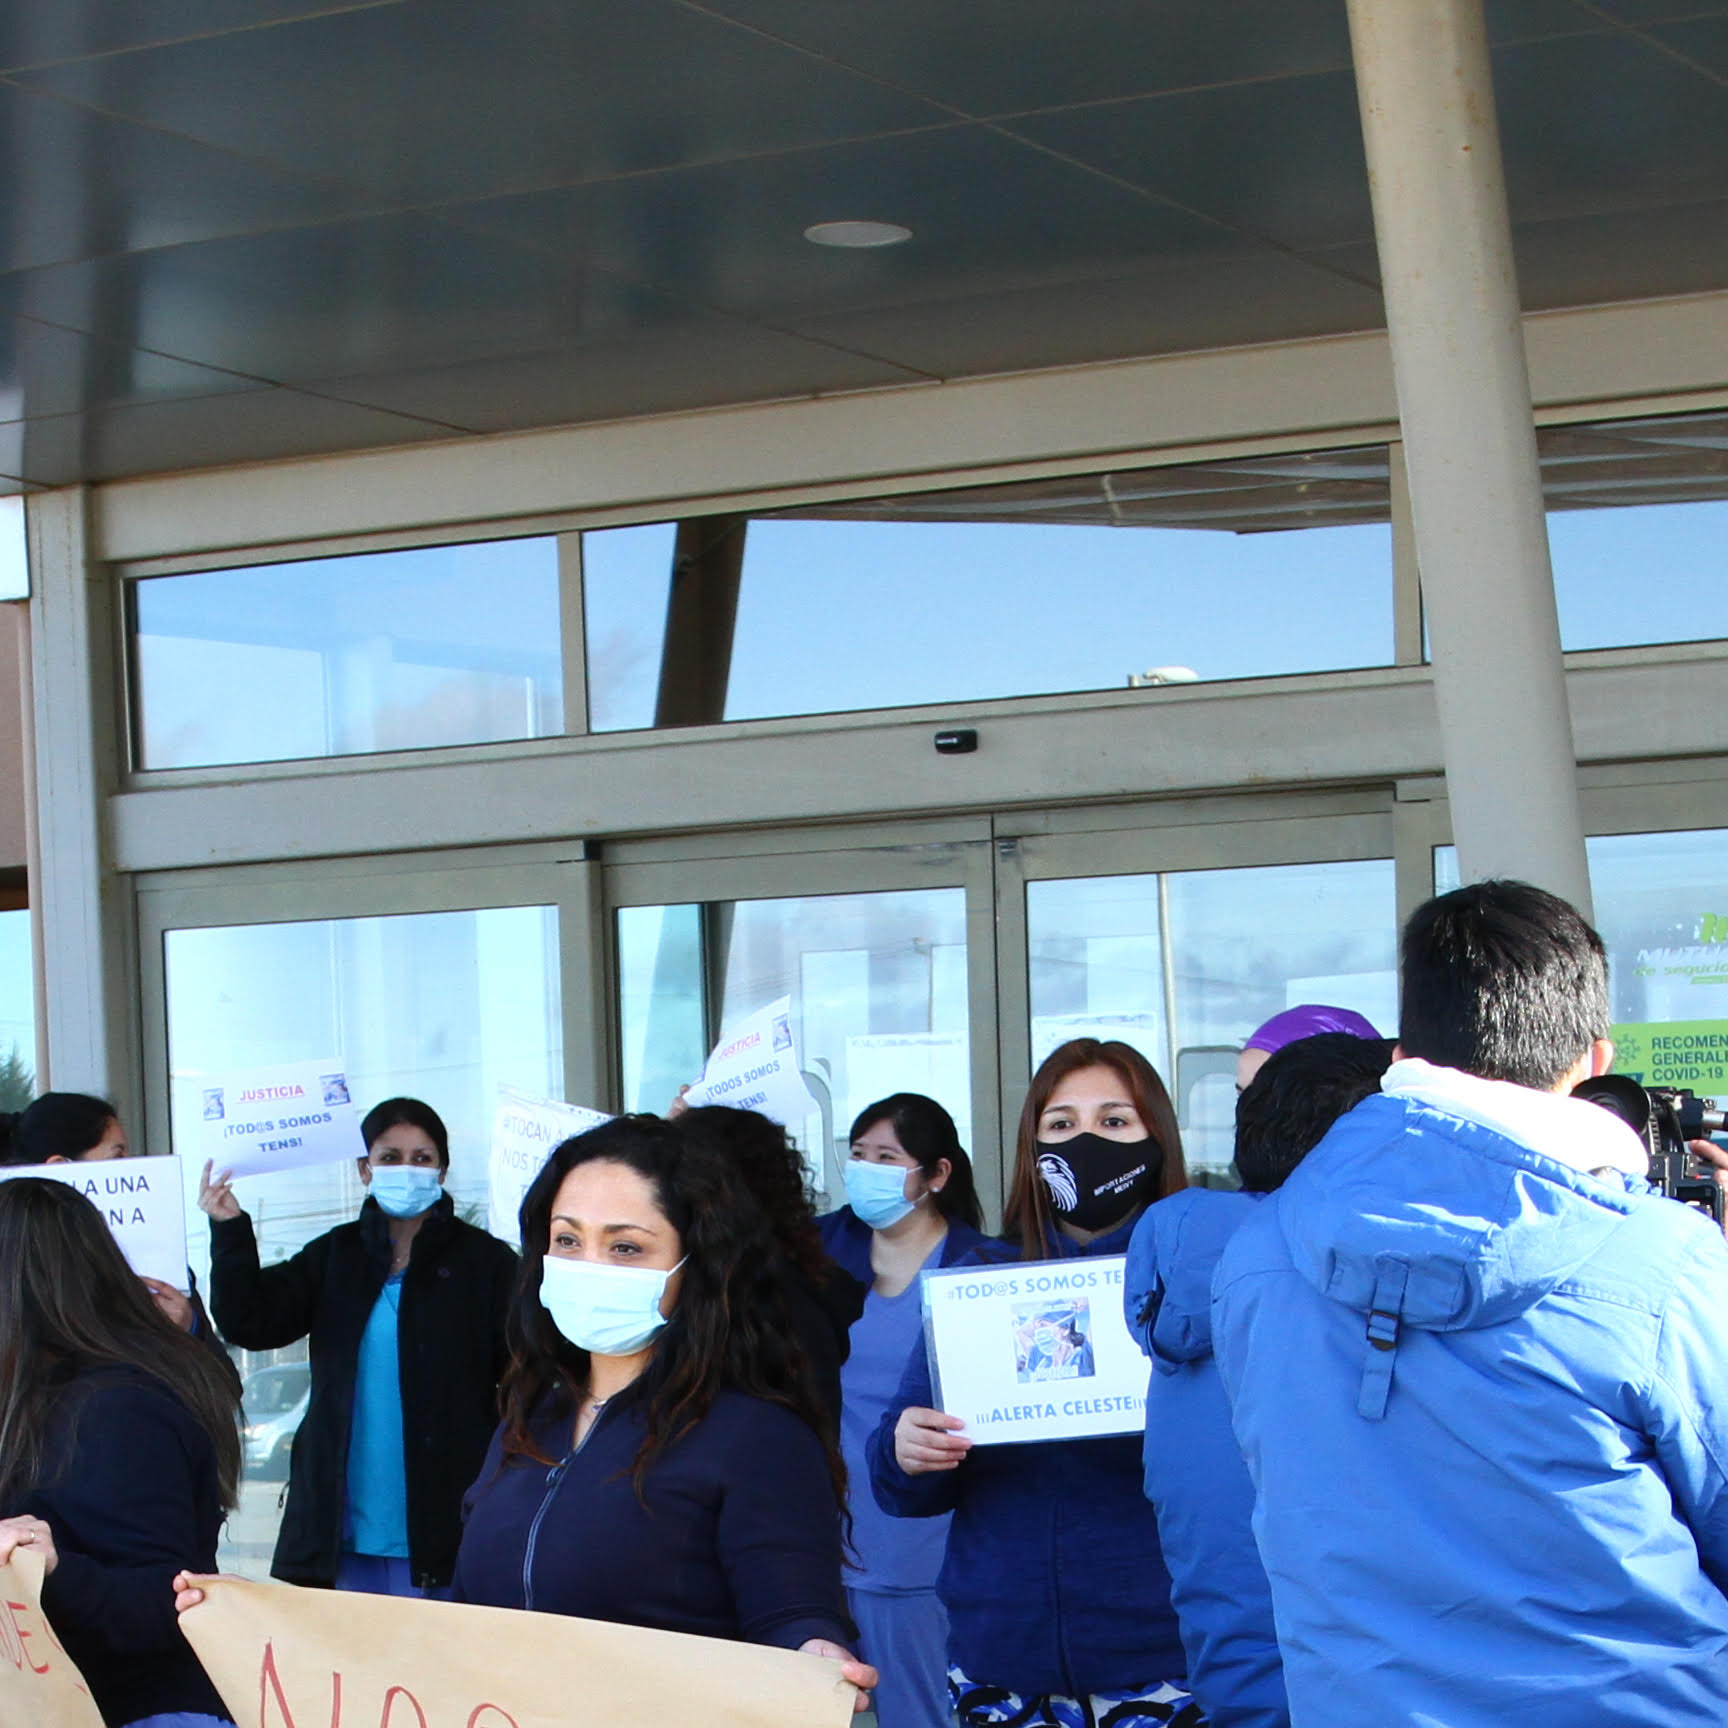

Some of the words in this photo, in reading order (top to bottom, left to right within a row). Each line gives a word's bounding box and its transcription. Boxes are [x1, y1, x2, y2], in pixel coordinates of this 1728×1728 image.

[743, 1060, 781, 1084] SOMOS
[1652, 1067, 1723, 1082] COVID-19
[239, 1084, 305, 1102] JUSTICIA
[277, 1112, 333, 1131] SOMOS
[257, 1137, 303, 1154] TENS!
[105, 1175, 150, 1195] UNA
[131, 1207, 145, 1225] A
[1026, 1271, 1097, 1293] SOMOS
